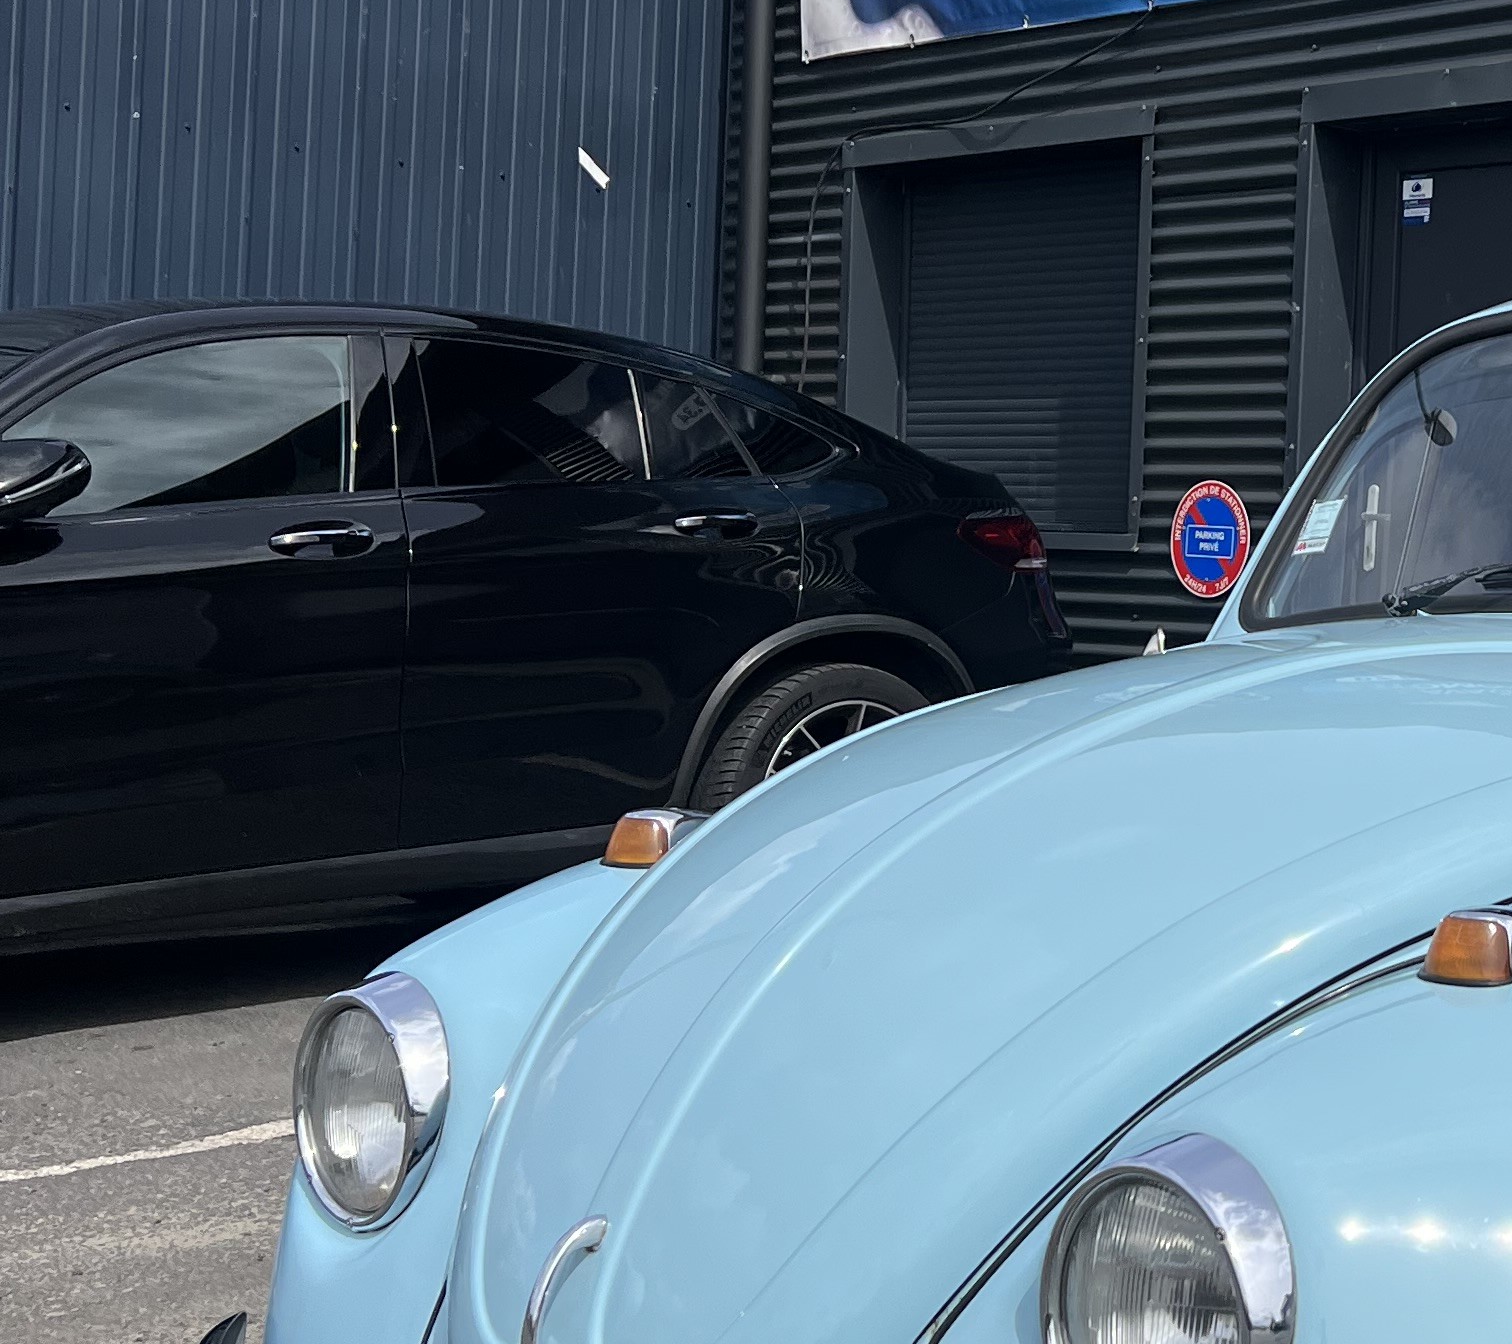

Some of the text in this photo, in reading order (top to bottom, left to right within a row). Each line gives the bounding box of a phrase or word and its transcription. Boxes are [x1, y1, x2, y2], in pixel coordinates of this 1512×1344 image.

[1174, 485, 1247, 544] INTERDICTION DE STATIONNER
[1195, 530, 1225, 541] PARKING
[1199, 541, 1220, 552] PRIVÉ
[1184, 574, 1207, 593] 24H/24
